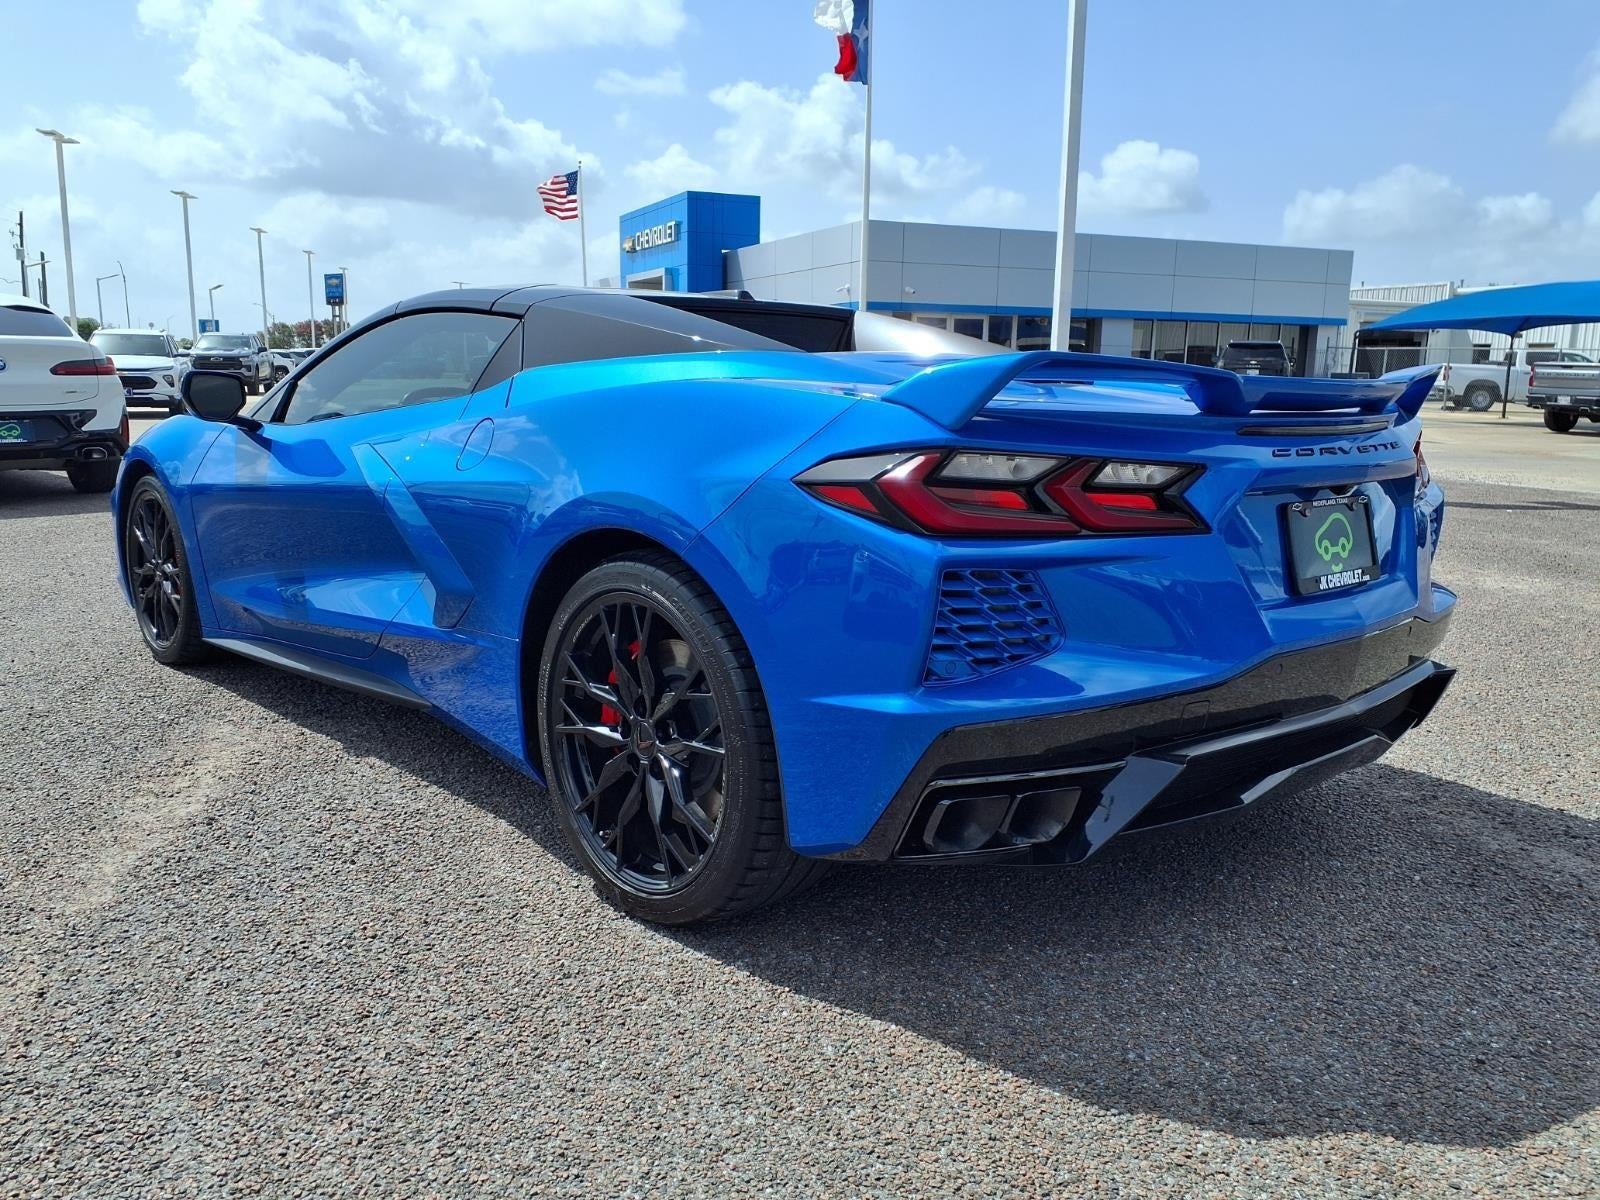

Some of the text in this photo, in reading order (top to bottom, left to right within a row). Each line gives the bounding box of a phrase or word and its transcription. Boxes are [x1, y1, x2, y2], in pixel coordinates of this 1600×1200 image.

[636, 221, 676, 250] CHEVROLET
[1272, 441, 1400, 457] CORVETTE
[1319, 575, 1329, 590] JK
